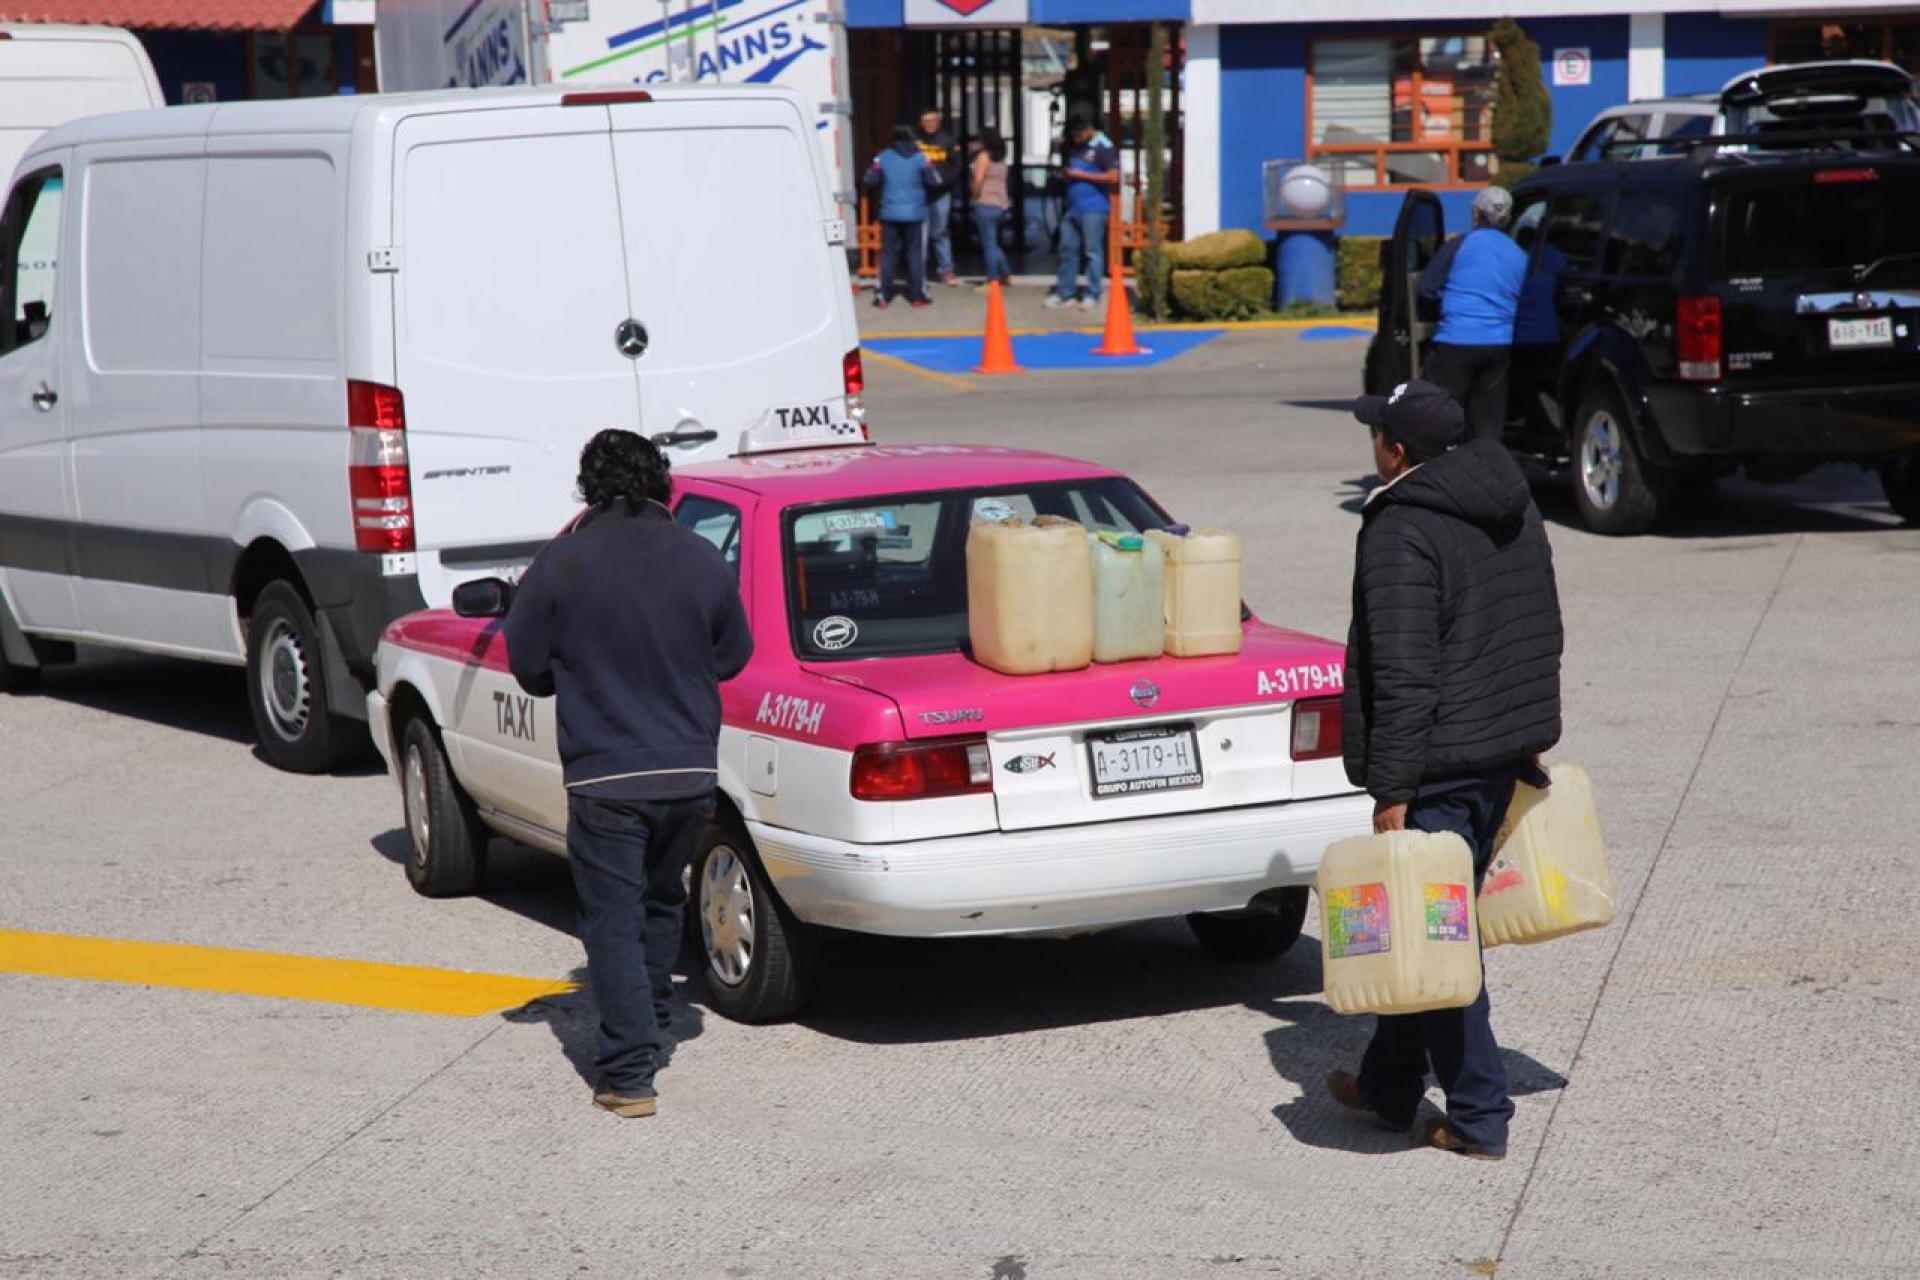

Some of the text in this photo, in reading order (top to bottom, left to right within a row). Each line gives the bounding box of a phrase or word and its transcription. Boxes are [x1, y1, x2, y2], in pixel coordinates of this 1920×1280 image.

[775, 405, 830, 429] TAXI
[1257, 663, 1344, 695] A-3179-H
[493, 691, 535, 742] TAXI
[756, 691, 826, 735] A-3179-H
[919, 708, 985, 724] TSURU
[1098, 741, 1189, 776] A-3179-H
[1098, 774, 1201, 794] GRUPO AUTOFIN MEXICO
